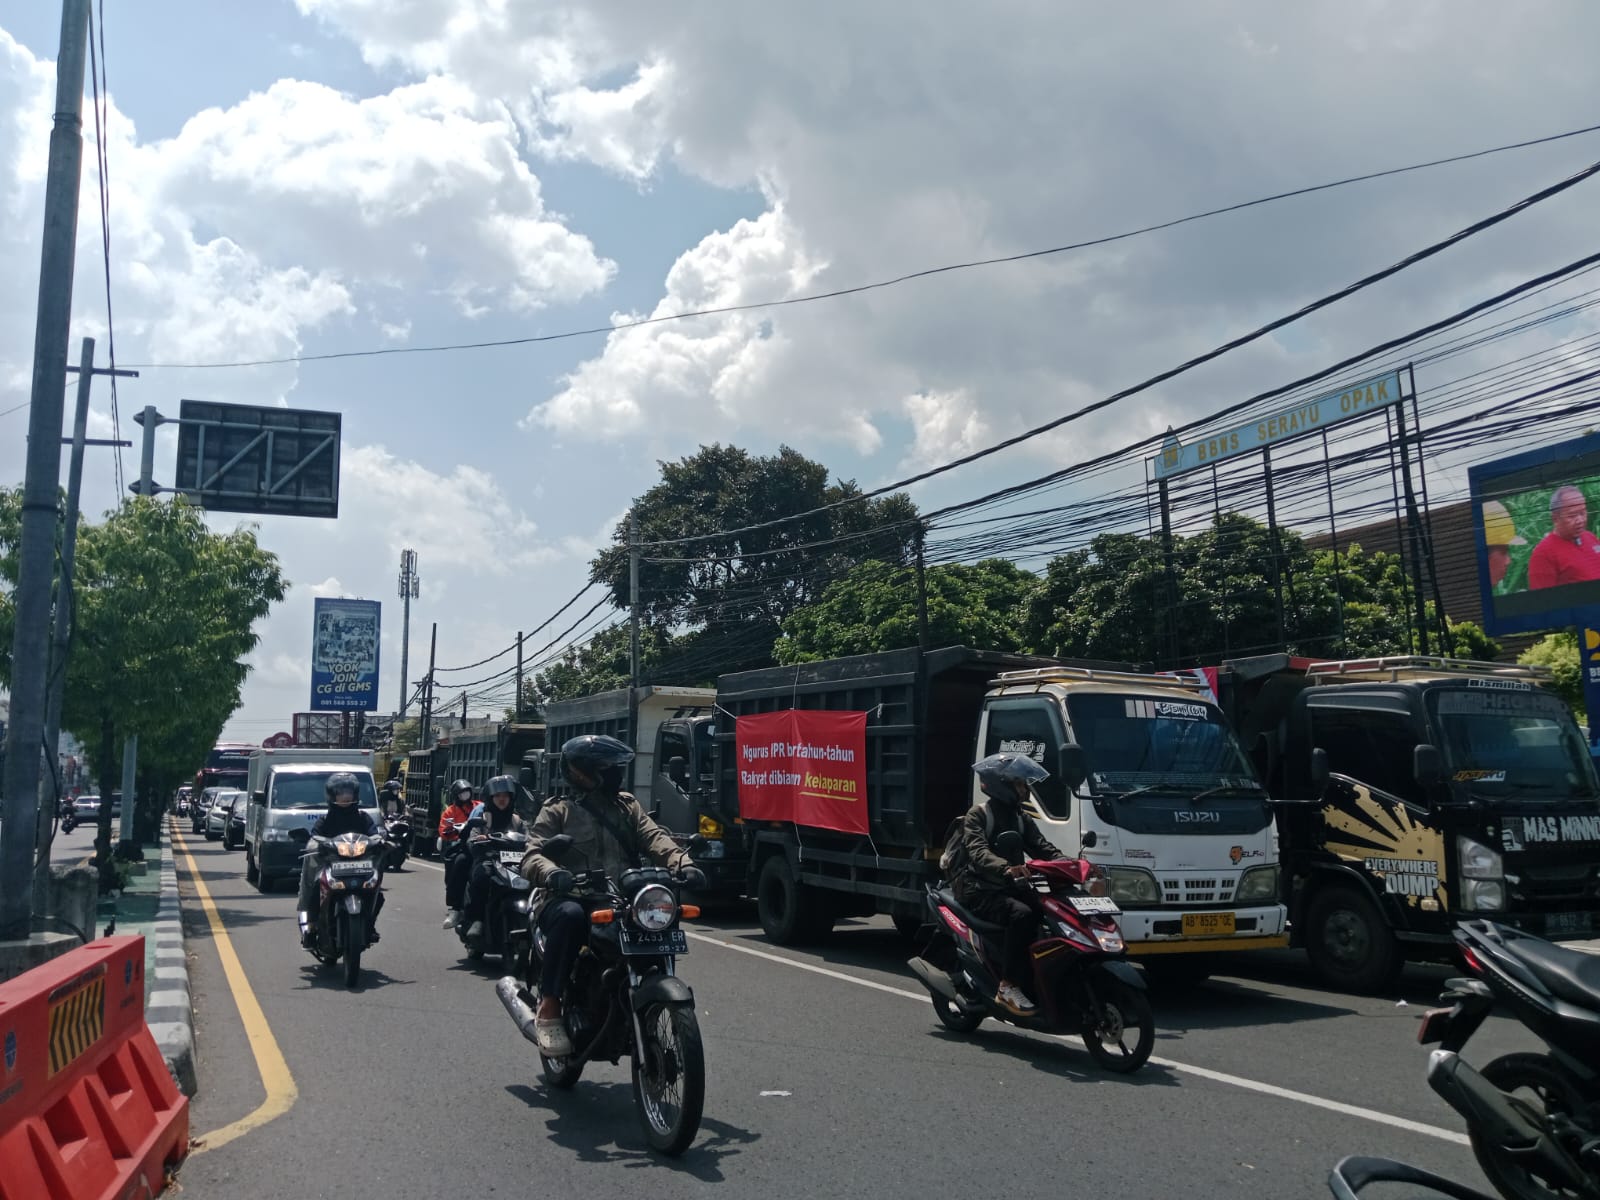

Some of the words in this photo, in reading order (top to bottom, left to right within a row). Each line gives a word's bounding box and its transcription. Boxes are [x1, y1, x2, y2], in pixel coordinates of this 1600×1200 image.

[1197, 433, 1239, 461] BBWS
[1257, 405, 1320, 441] SERAYU
[1340, 381, 1389, 413] OPAK
[328, 664, 359, 673] YOOK
[331, 673, 357, 683] JOIN
[317, 684, 332, 694] CG
[335, 683, 345, 692] di
[348, 682, 371, 692] GMS
[1470, 680, 1530, 691] Bismillah
[743, 745, 769, 763] Ngurus
[770, 742, 785, 758] IPR
[741, 770, 767, 789] Rakyat
[804, 771, 856, 794] kelaparan
[1174, 811, 1219, 822] ISUZU
[1523, 816, 1559, 842] MAS
[1365, 857, 1437, 874] EVERYWHERE
[1386, 873, 1438, 896] DUMP
[671, 931, 684, 942] ER
